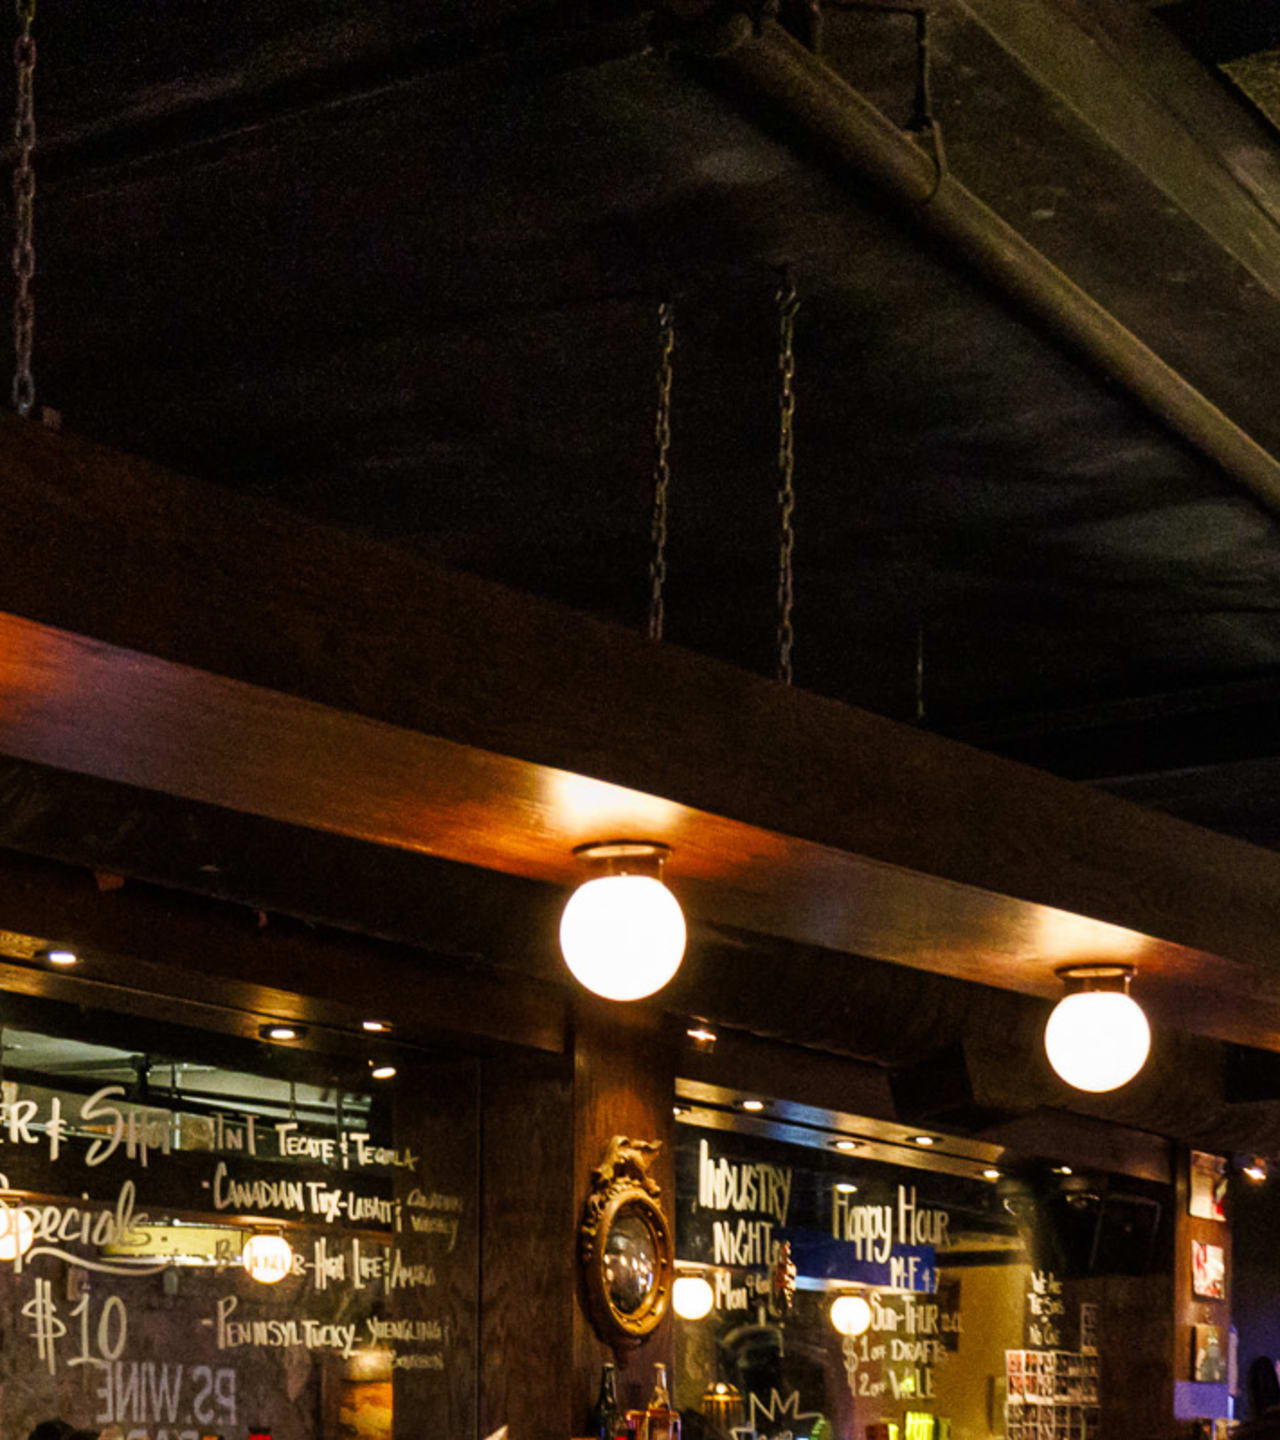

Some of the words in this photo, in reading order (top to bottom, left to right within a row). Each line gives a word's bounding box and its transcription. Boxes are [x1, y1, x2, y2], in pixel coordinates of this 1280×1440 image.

[274, 1122, 336, 1159] TECATE
[213, 1161, 306, 1213] CANADIAN
[699, 1138, 793, 1228] INDUSTRY
[832, 1184, 893, 1264] Happy
[21, 1277, 128, 1376] $10
